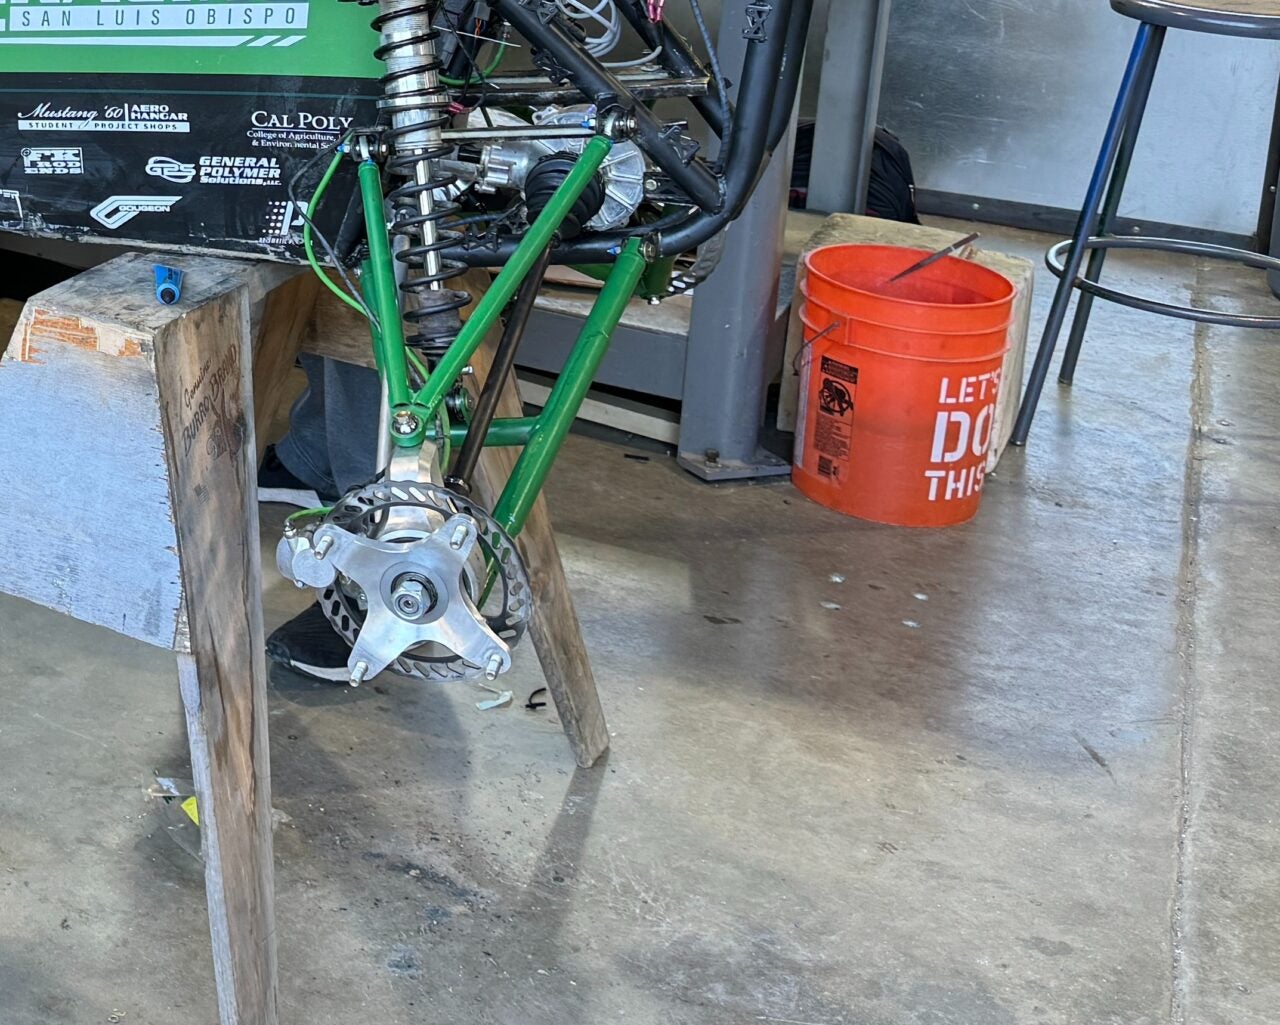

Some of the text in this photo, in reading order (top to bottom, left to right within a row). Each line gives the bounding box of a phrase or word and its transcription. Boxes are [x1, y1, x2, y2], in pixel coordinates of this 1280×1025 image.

[22, 7, 296, 26] SAN LUIS OBISPO
[17, 102, 99, 129] Mustang
[131, 104, 170, 113] AERO
[130, 112, 188, 121] HANGAR
[251, 111, 354, 130] CAL POLY
[247, 130, 277, 139] College
[288, 132, 337, 142] Agriculture,
[199, 156, 280, 168] GENERAL
[199, 167, 281, 178] POLYMER
[184, 358, 212, 408] Genuine
[938, 367, 1001, 404] LET'S
[182, 396, 211, 458] BURRO
[930, 403, 995, 463] DO
[924, 460, 986, 501] THIS
